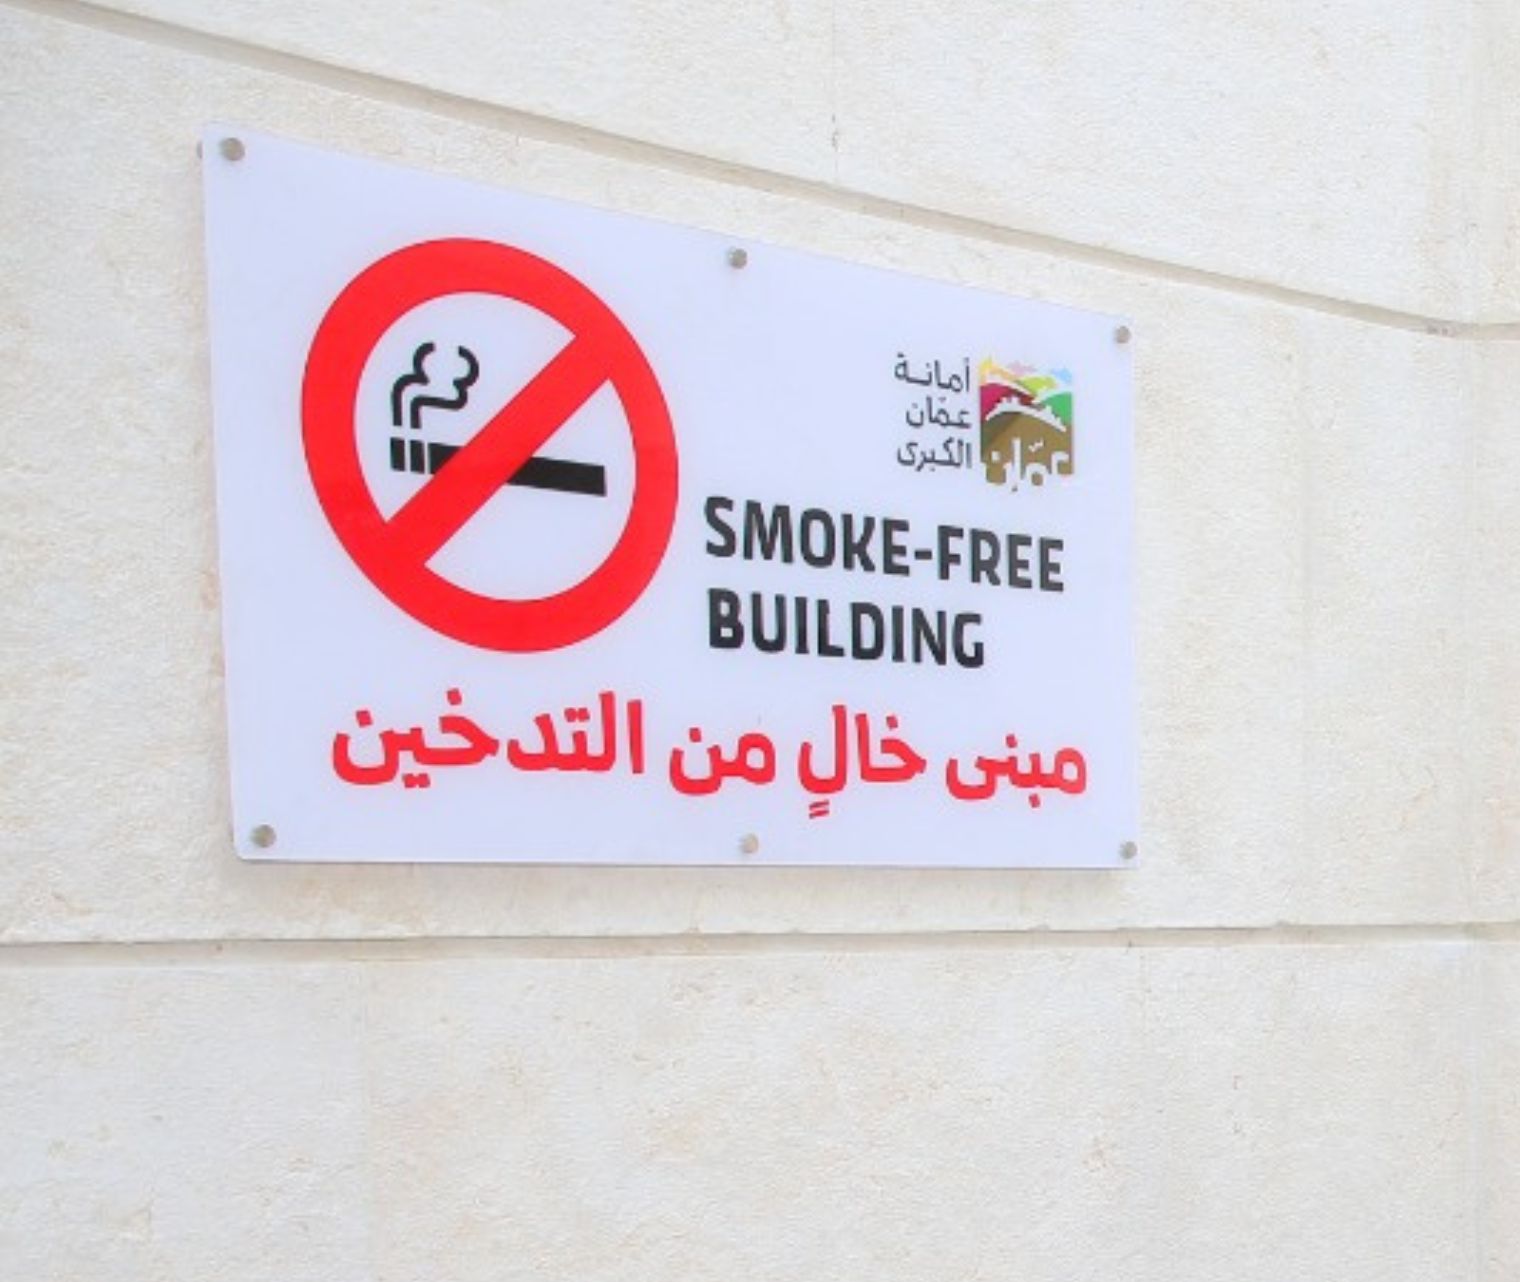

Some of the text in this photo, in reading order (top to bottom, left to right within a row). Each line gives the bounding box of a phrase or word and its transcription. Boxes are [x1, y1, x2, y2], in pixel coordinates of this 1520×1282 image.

[897, 437, 973, 472] الكبرى
[704, 496, 1065, 593] SMOKE-FREE
[708, 587, 984, 669] BUILDING
[330, 688, 647, 790] التدخين
[668, 727, 777, 798] من
[945, 736, 1088, 808] مبنى
